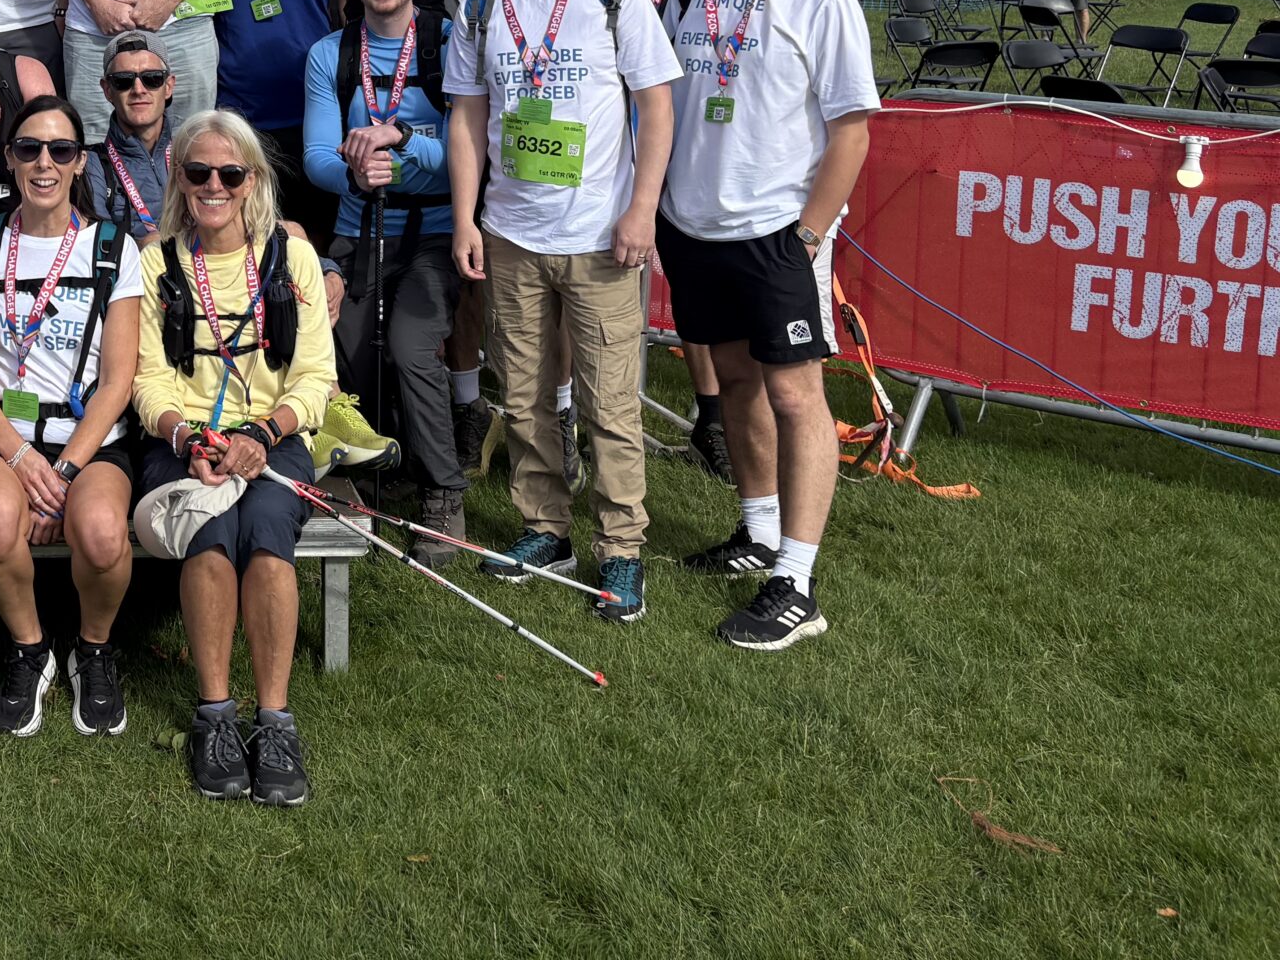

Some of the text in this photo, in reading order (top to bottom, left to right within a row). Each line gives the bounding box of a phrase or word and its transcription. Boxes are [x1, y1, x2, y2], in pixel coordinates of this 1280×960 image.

[508, 16, 523, 39] 2026
[707, 13, 718, 36] 2026
[391, 27, 415, 104] 2026 CHALLENGER
[547, 67, 589, 82] STEP
[686, 58, 713, 75] FOR
[362, 53, 376, 106] CHALLENGER
[542, 85, 575, 100] SEB
[517, 135, 563, 157] 6352
[107, 143, 144, 210] 2026 CHALLENGER
[539, 169, 549, 177] 1st
[955, 171, 1150, 259] PUSH
[6, 221, 20, 316] 2026 CHALLENGER
[32, 228, 77, 318] 2026 CHALLENGER
[193, 255, 204, 283] 2026
[49, 319, 84, 337] STE
[44, 334, 78, 352] SEB
